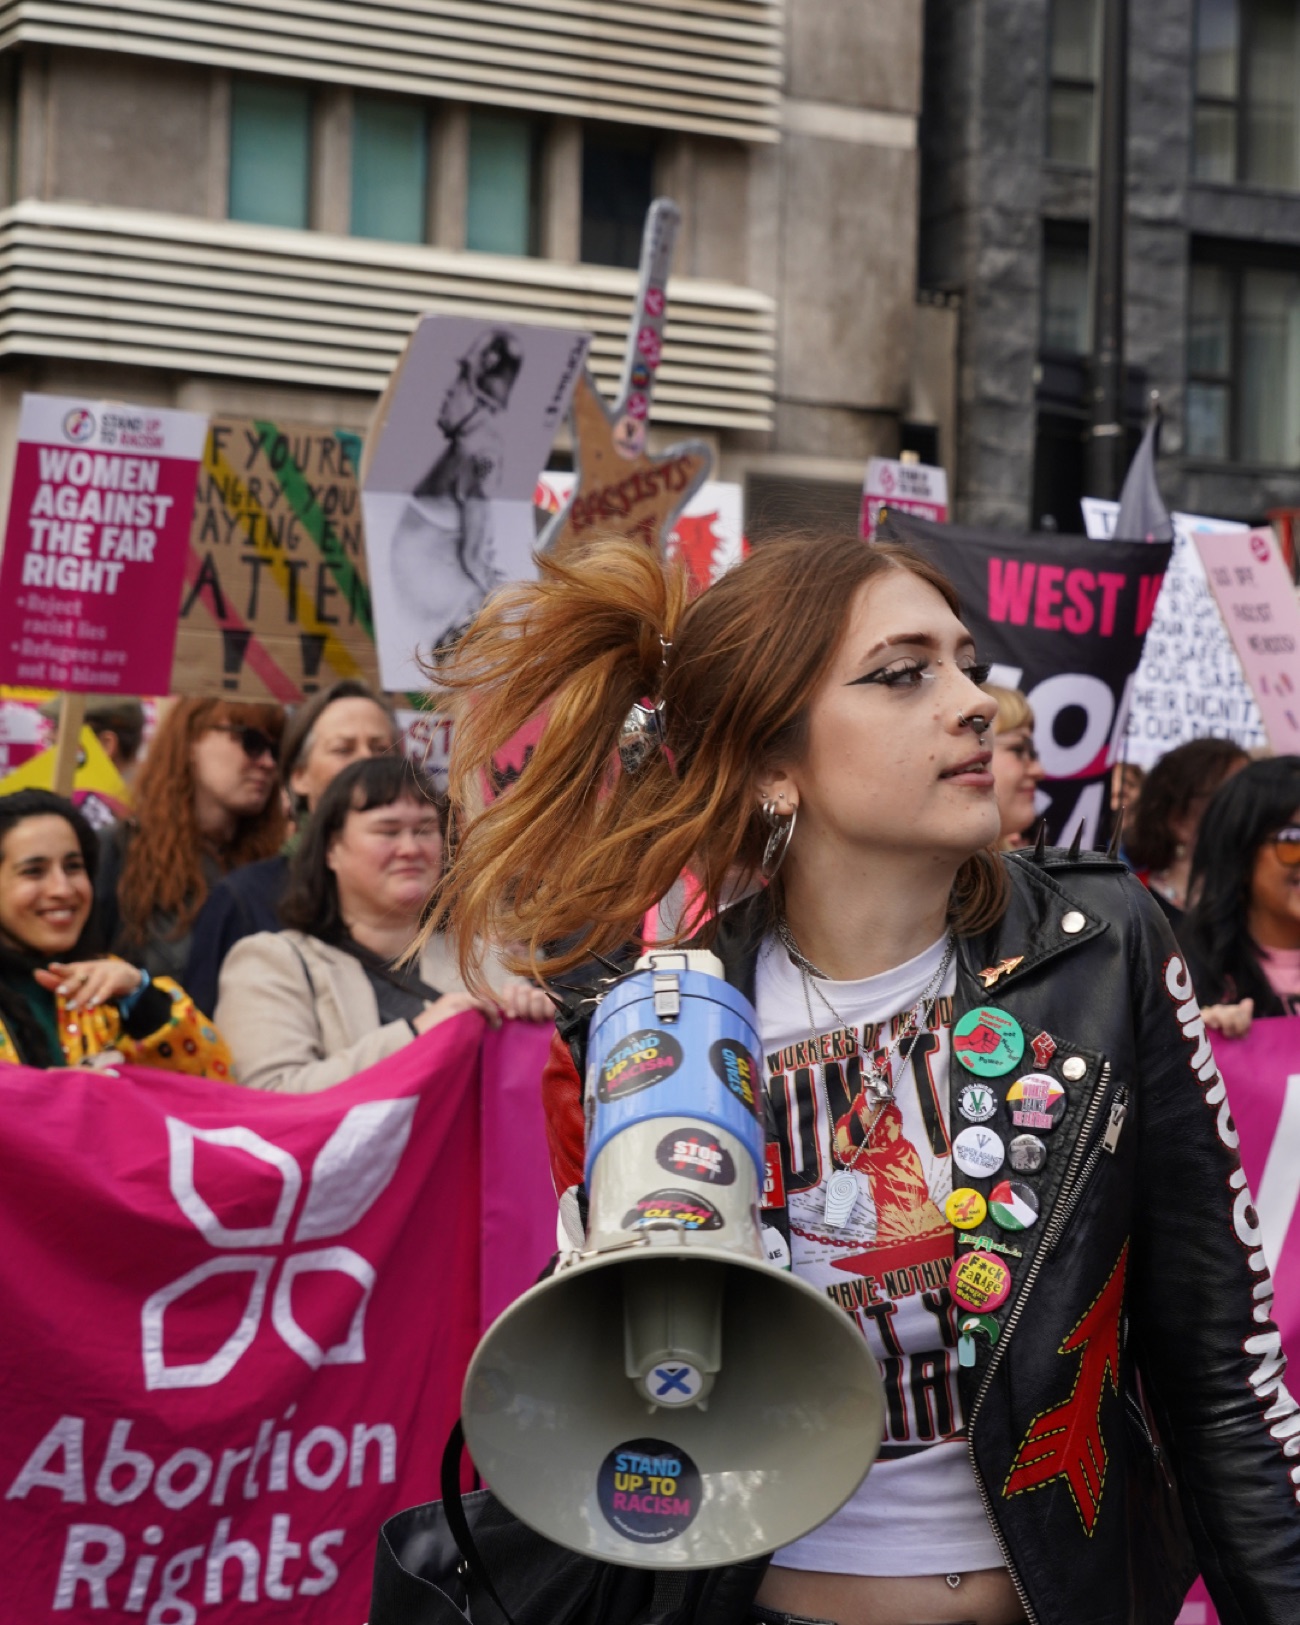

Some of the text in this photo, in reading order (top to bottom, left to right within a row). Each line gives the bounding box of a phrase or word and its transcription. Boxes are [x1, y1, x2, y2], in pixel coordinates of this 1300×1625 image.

[100, 431, 165, 448] TO RACISM
[101, 414, 162, 431] STAND UP
[38, 449, 160, 492] WOMEN
[244, 428, 358, 478] YOU'RE
[30, 484, 174, 529] AGAINST
[29, 519, 158, 562] THE FAR
[193, 508, 300, 550] AYING
[22, 554, 124, 594] RIGHT
[987, 558, 1126, 637] WEST
[981, 1010, 1012, 1027] Workers
[605, 1036, 660, 1072] STAND
[606, 1048, 658, 1081] UP TO
[767, 1027, 859, 1076] WORKERS
[863, 1021, 887, 1051] OF
[607, 1056, 675, 1093] RACISM
[721, 1047, 744, 1096] STAND
[736, 1057, 755, 1104] UP TO
[673, 1140, 723, 1165] STOP
[643, 1209, 672, 1218] TO
[675, 1212, 706, 1225] UP
[826, 1275, 878, 1314] HAVE
[5, 1403, 397, 1510] Abortion
[615, 1453, 682, 1478] STAND
[614, 1472, 677, 1496] UP TO
[612, 1492, 690, 1517] RACISM
[52, 1513, 346, 1625] Rights
